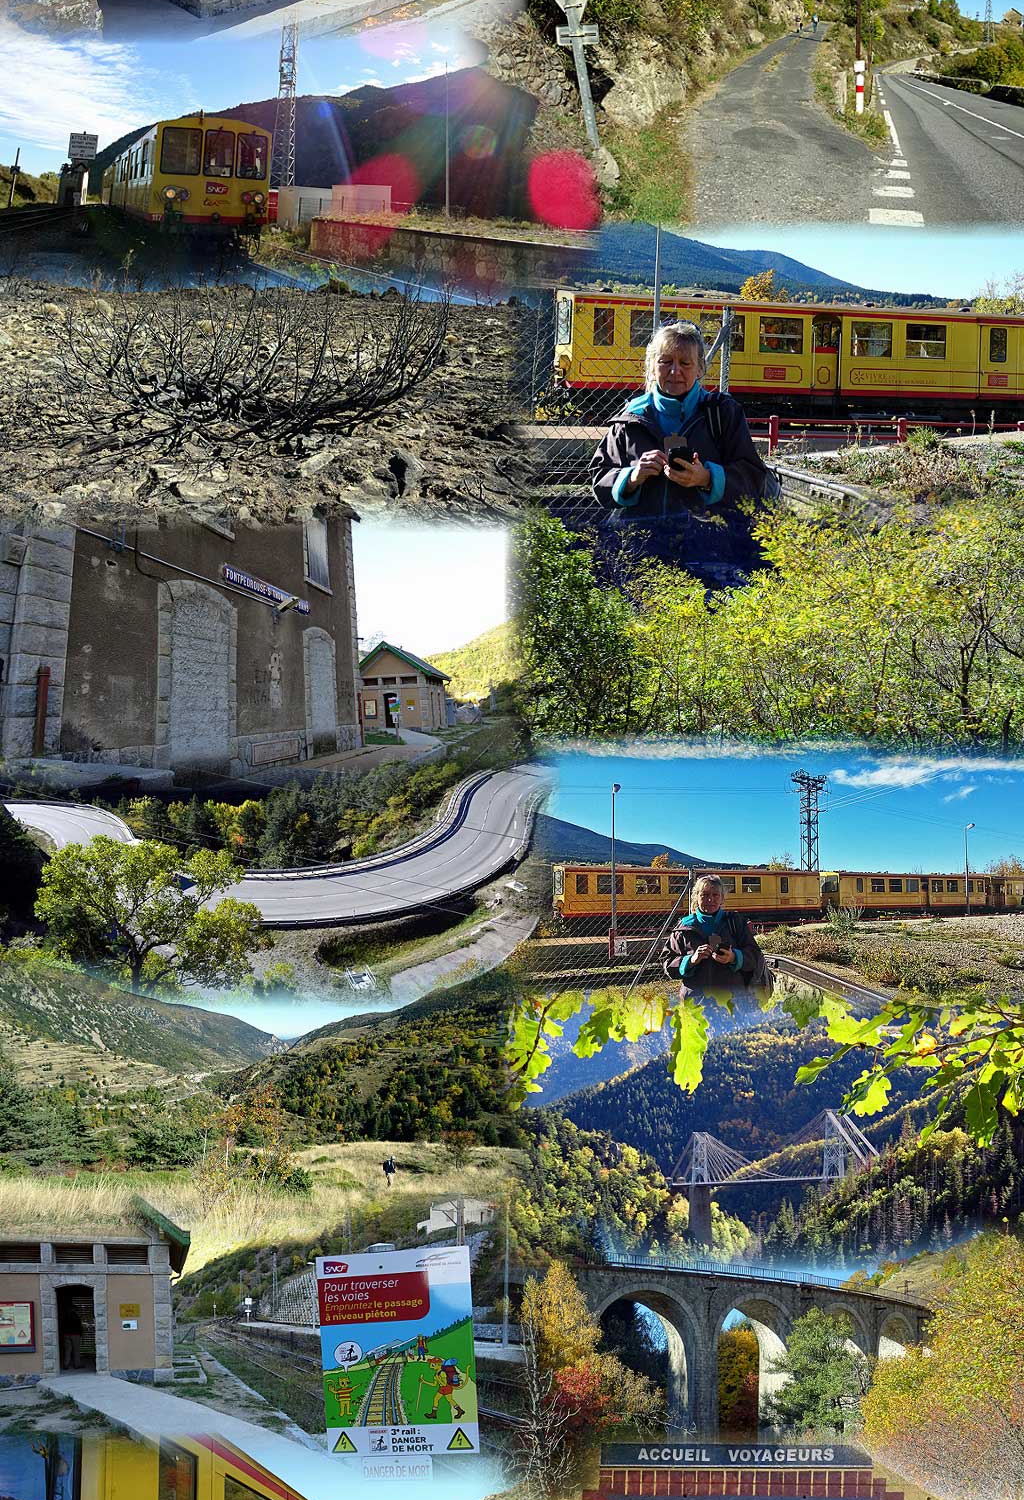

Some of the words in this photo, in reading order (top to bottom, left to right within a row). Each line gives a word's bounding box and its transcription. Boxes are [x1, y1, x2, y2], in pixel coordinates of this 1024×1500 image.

[207, 186, 227, 194] SNCF
[325, 1265, 347, 1274] SNCF
[323, 1282, 349, 1292] Pour
[350, 1278, 399, 1291] traverser
[324, 1292, 339, 1303] les
[341, 1290, 369, 1301] voies
[325, 1301, 373, 1313] Empruntez
[373, 1298, 382, 1308] le
[384, 1299, 423, 1309] passage
[325, 1312, 331, 1321] à
[332, 1311, 365, 1321] niveau
[365, 1309, 397, 1322] piéton
[391, 1436, 427, 1444] DANGER
[392, 1445, 405, 1453] DE
[406, 1444, 434, 1452] MORT
[637, 1448, 710, 1462] ACCUEIL
[727, 1448, 835, 1462] VOYAGEURS
[363, 1465, 395, 1478] DANGER
[396, 1465, 408, 1477] DE
[408, 1464, 431, 1477] MORT
